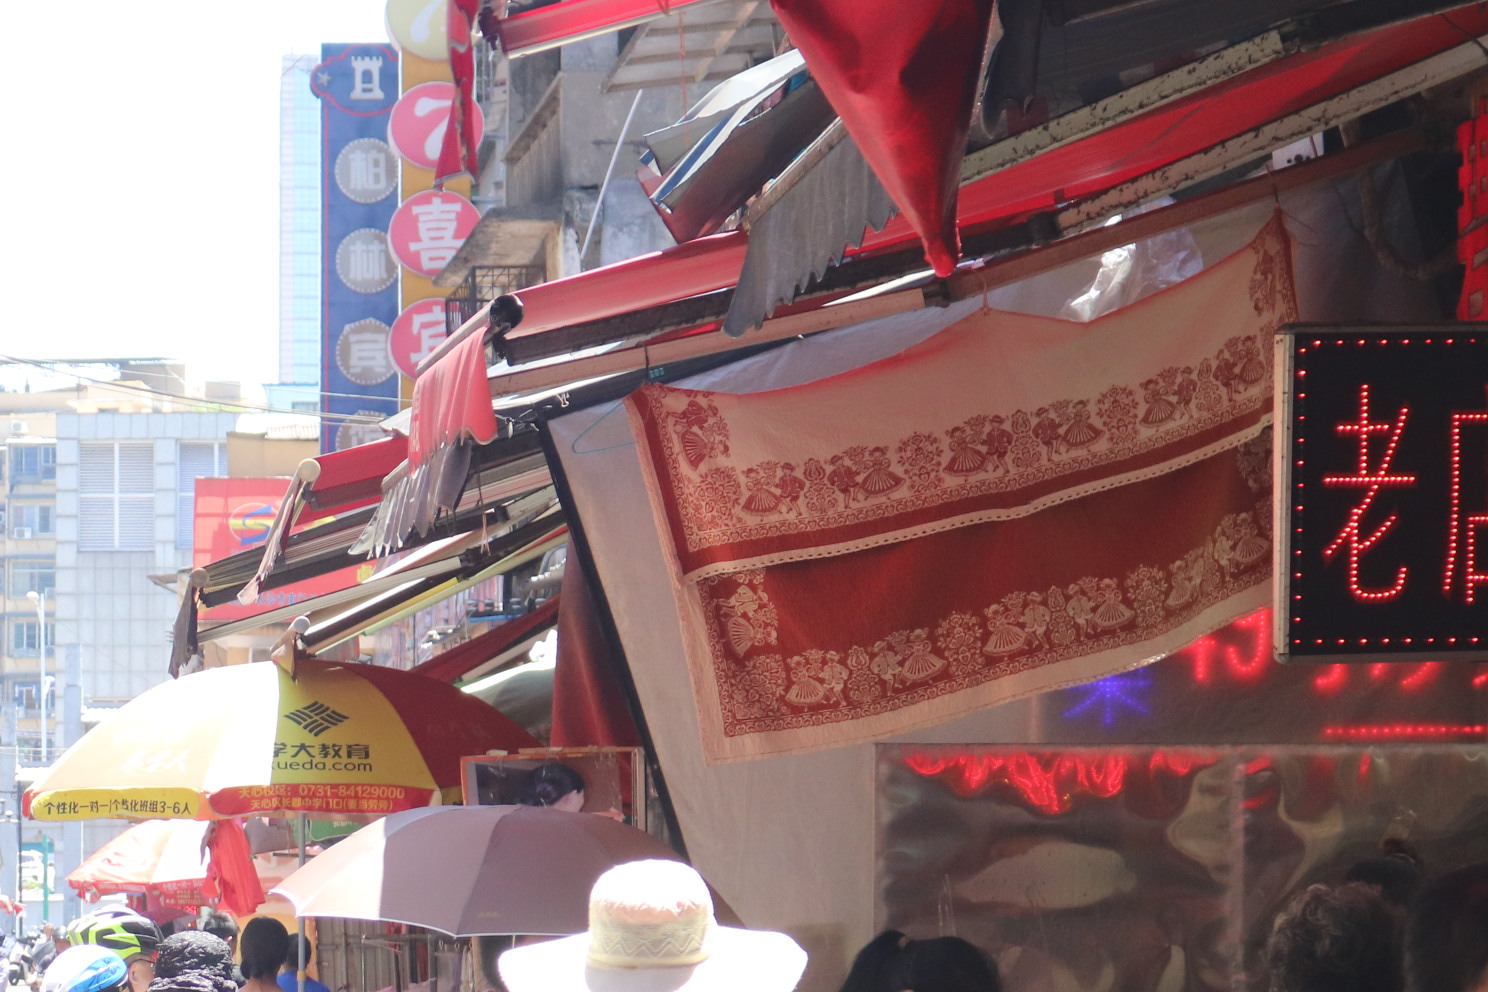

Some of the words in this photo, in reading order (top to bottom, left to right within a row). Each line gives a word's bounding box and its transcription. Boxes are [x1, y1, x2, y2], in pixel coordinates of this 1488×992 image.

[273, 743, 371, 760] 学大教育
[272, 760, 373, 773] ueda.com
[299, 785, 405, 799] 0731-84129000
